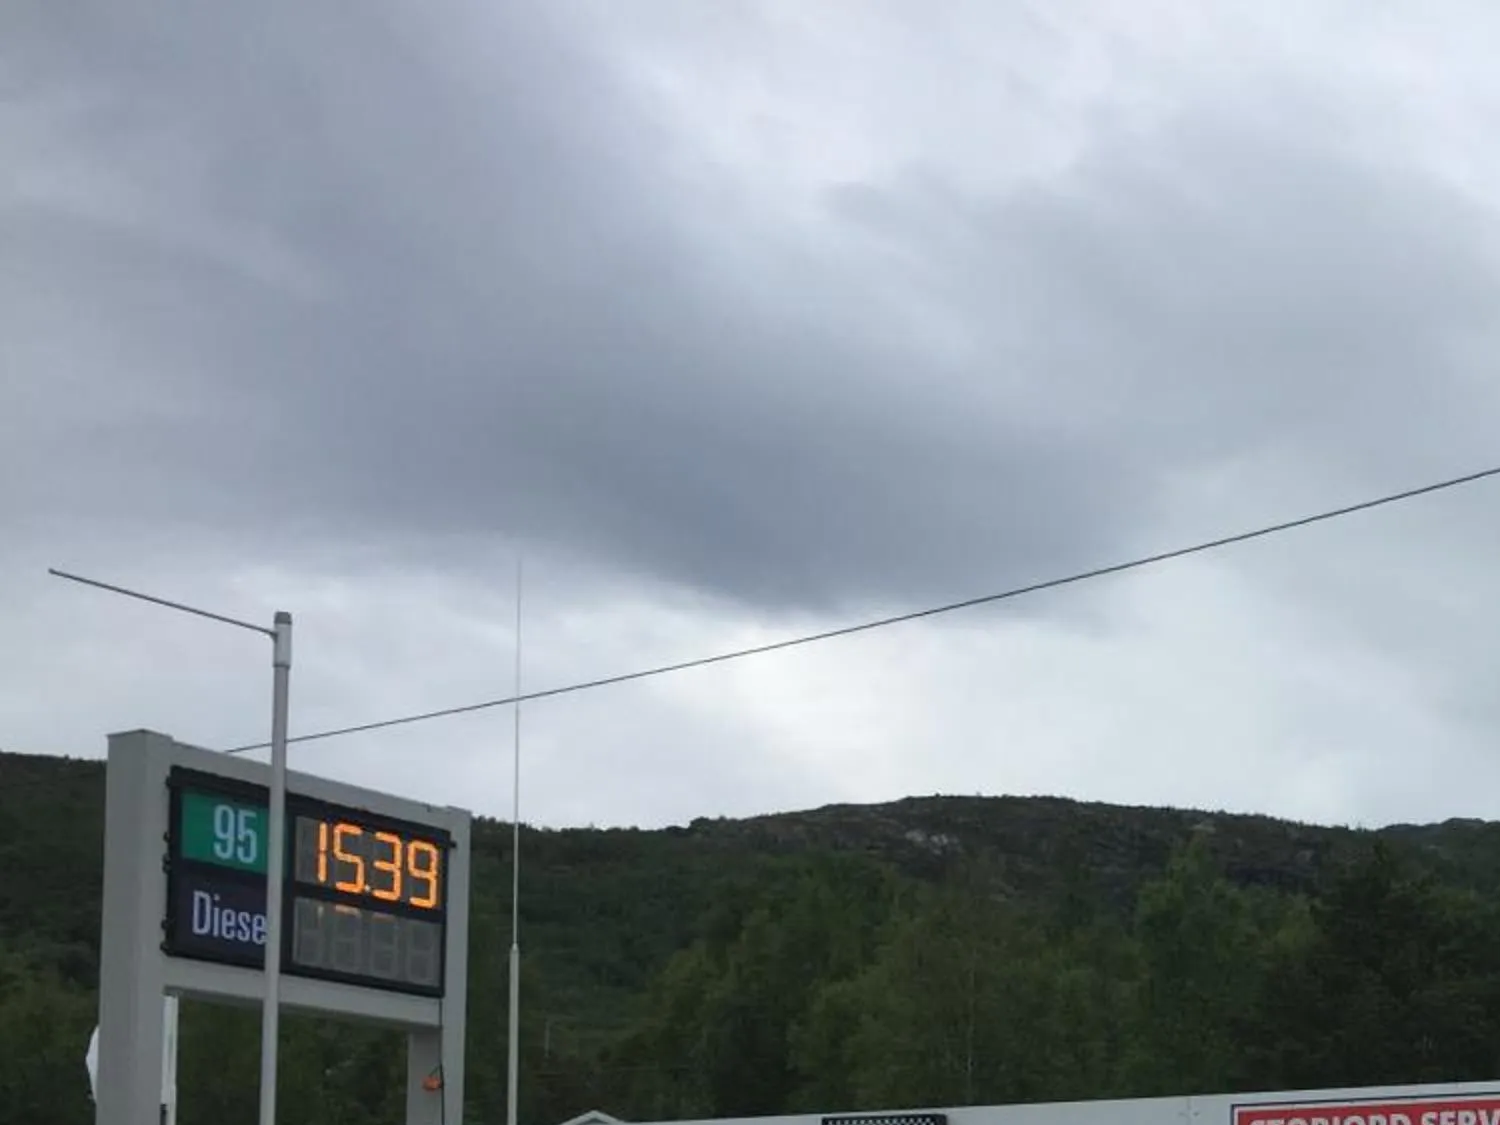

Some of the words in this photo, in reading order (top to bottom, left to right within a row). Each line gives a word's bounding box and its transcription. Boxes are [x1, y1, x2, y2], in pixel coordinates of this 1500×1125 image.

[213, 804, 257, 864] 95
[317, 821, 438, 909] 15.39
[192, 890, 268, 945] Diese
